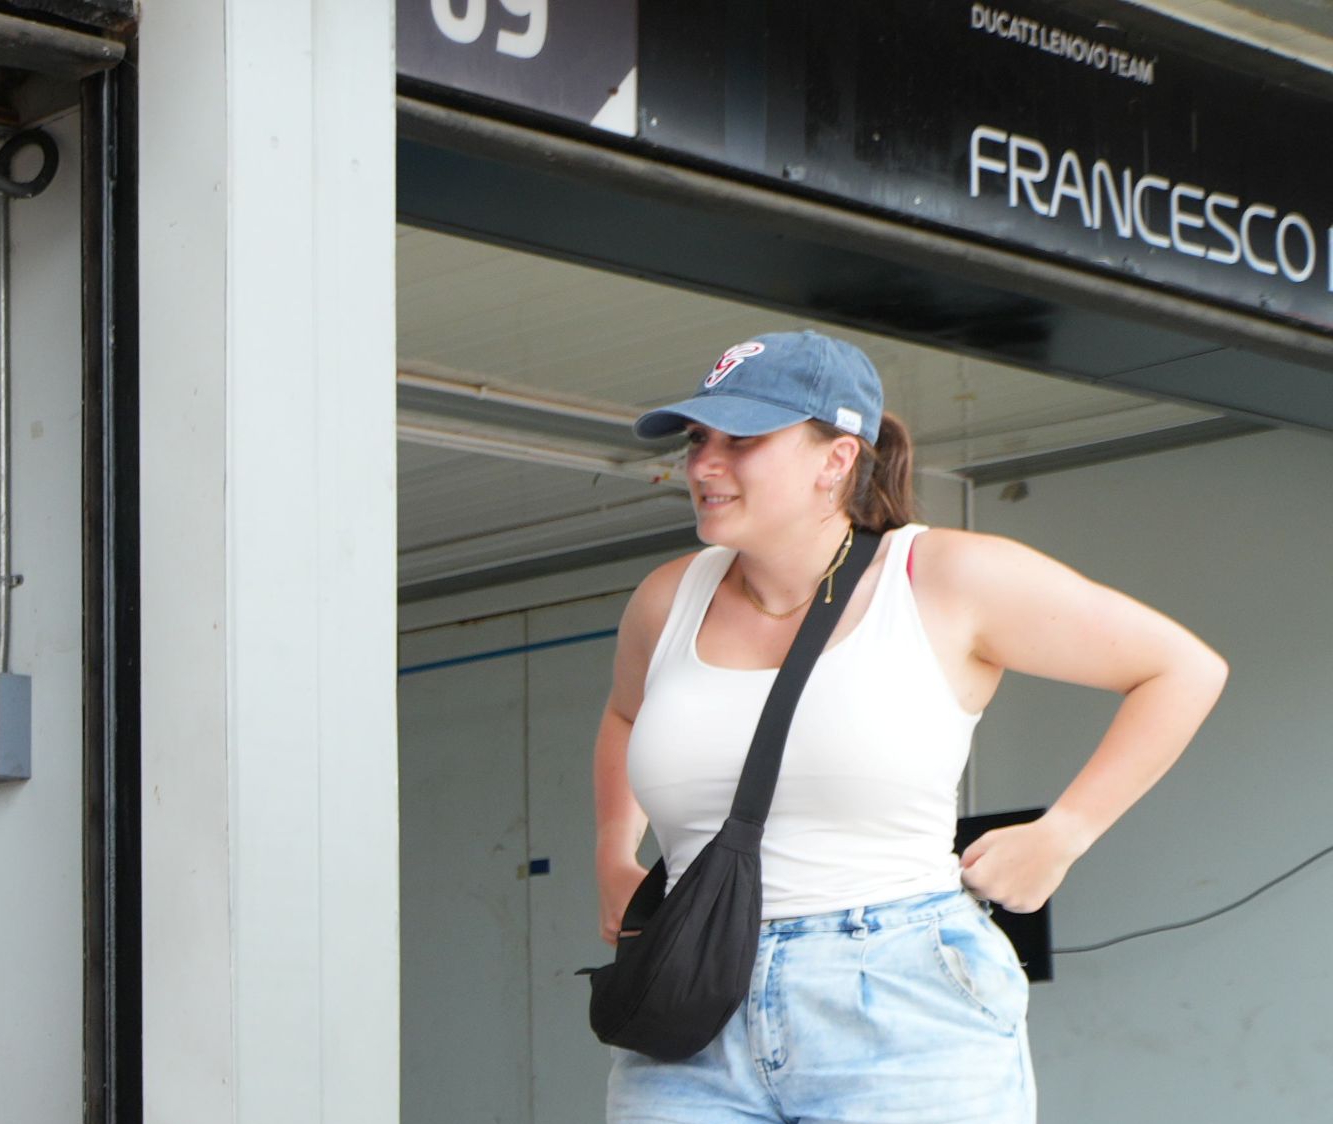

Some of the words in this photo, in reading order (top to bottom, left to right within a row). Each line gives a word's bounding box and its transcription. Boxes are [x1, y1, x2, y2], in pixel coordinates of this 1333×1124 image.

[971, 4, 1039, 47] DUCATI
[1040, 25, 1108, 70] LENOVO
[1108, 49, 1155, 85] TEAM
[970, 125, 1317, 282] FRANCESCO
